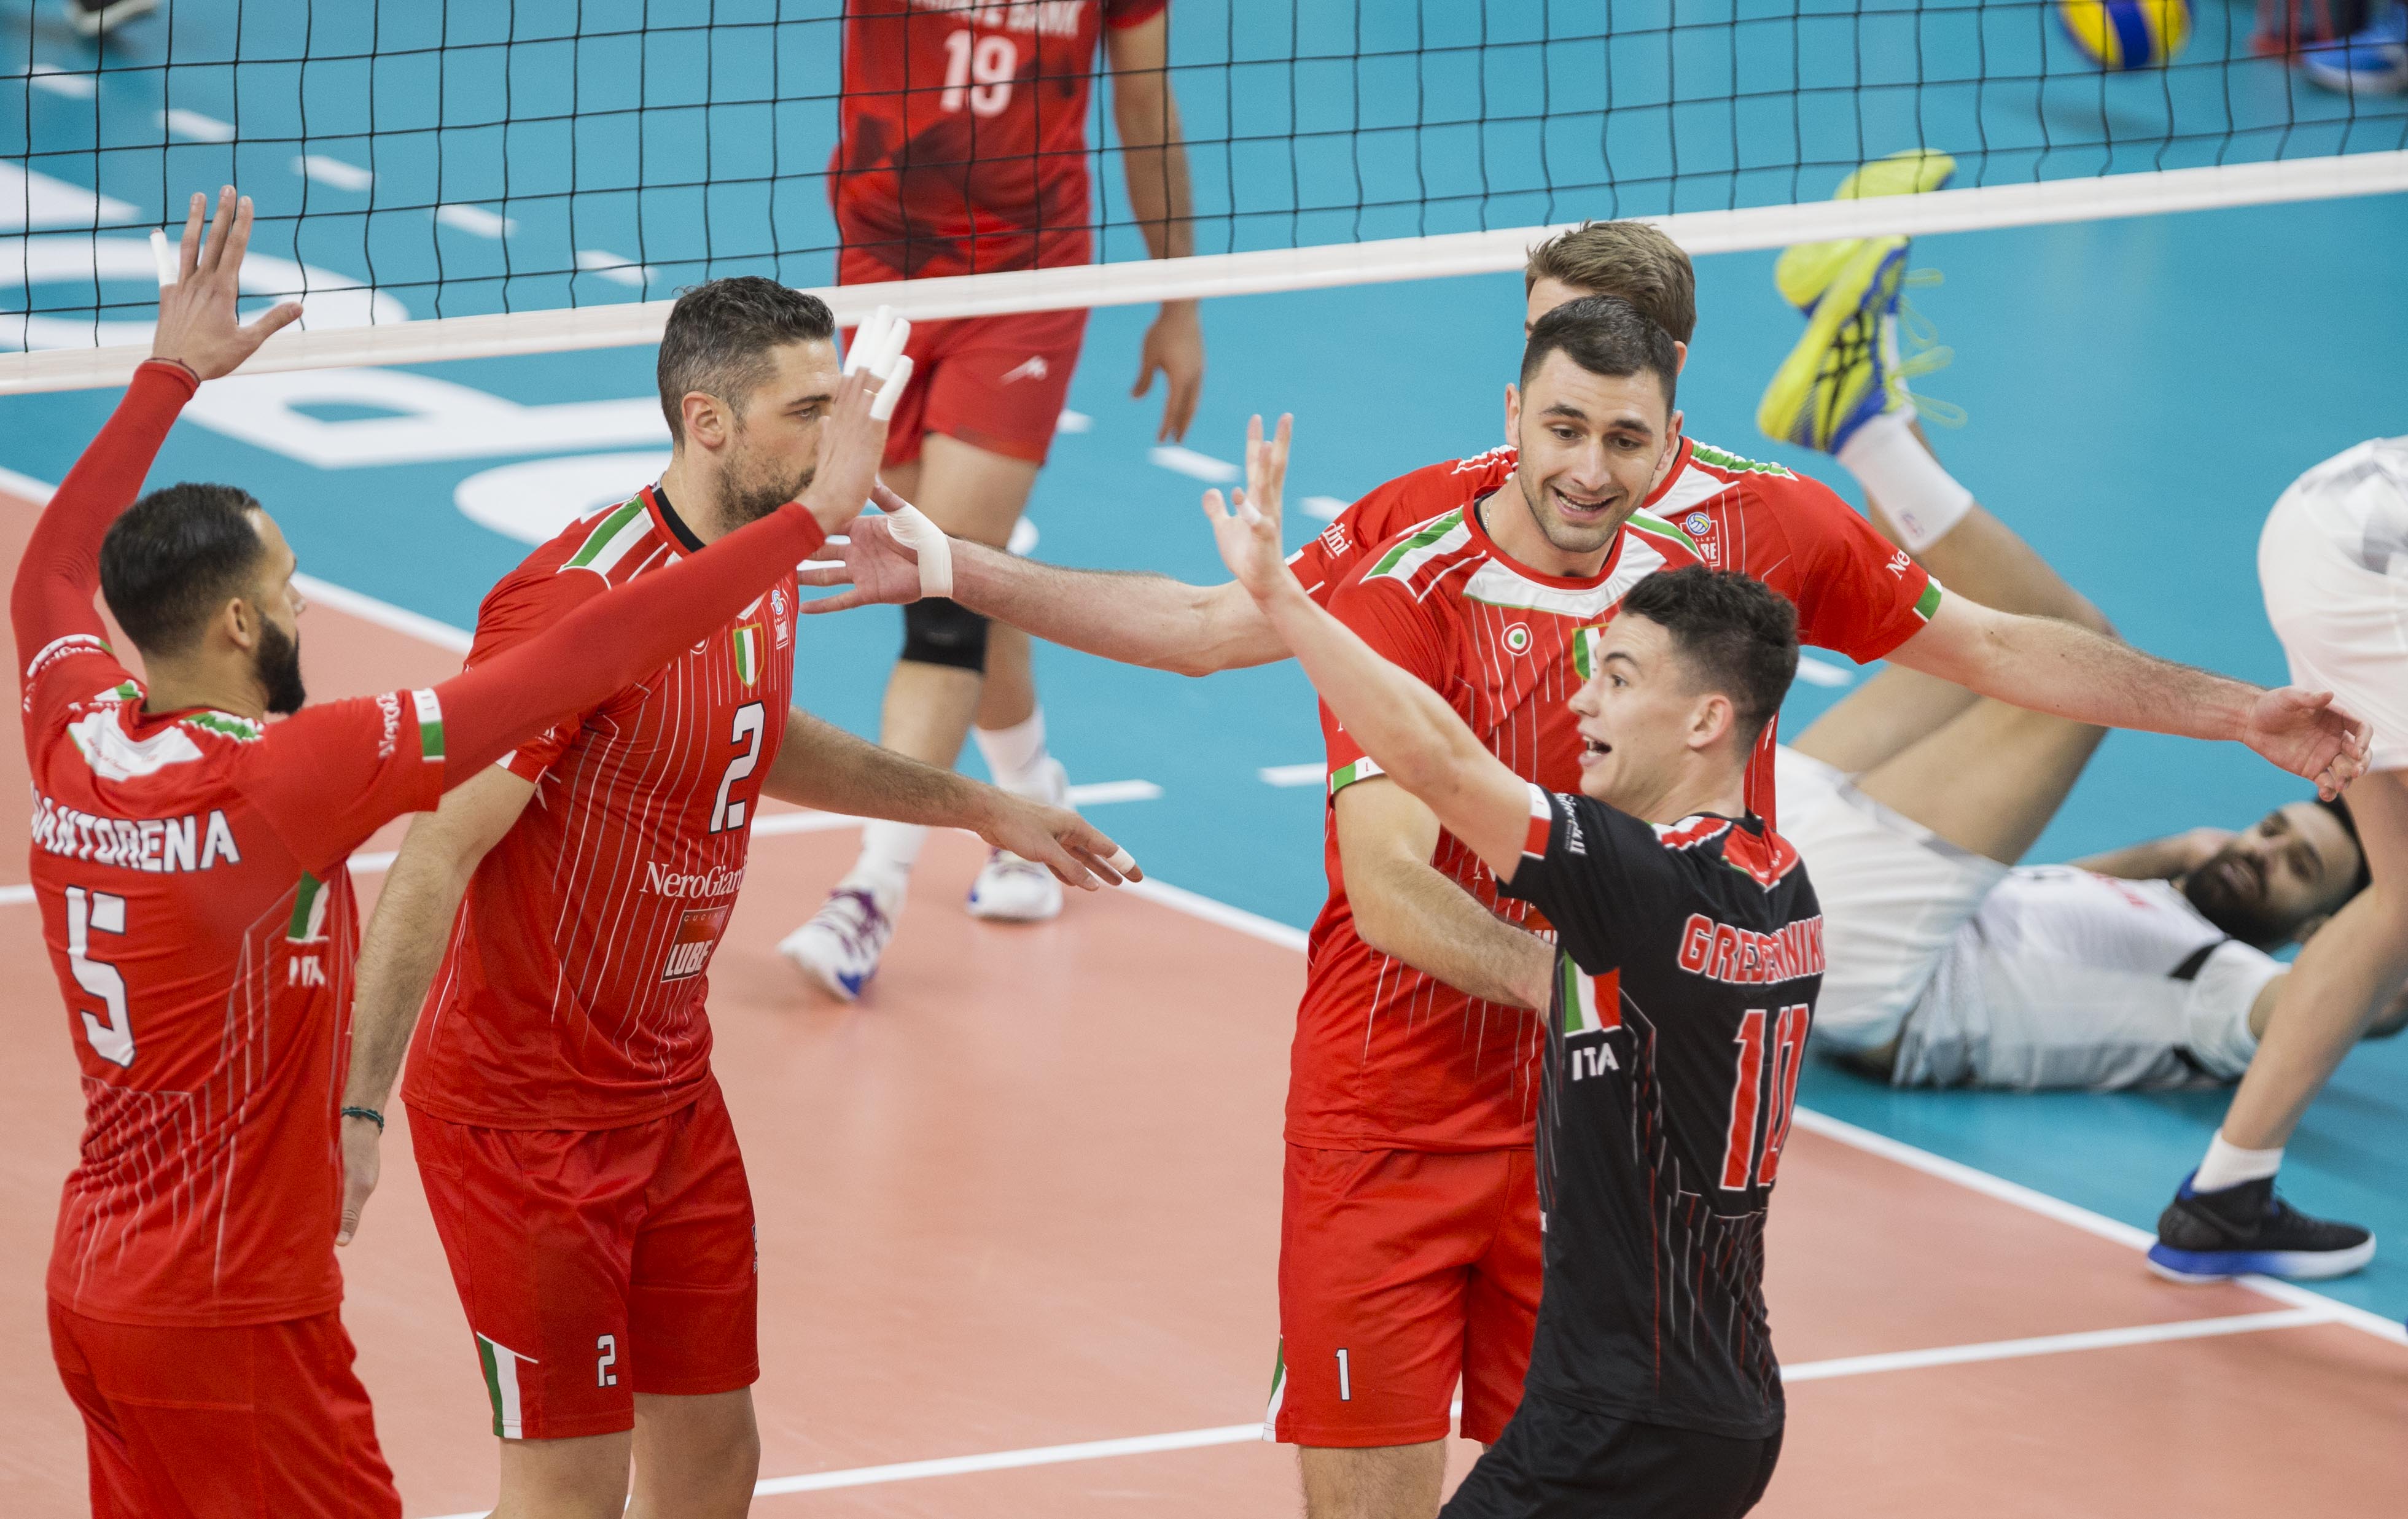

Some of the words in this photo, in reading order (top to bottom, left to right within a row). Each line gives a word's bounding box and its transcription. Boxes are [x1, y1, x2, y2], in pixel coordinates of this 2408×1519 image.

[939, 29, 1018, 118] 19
[709, 700, 766, 835] 2
[64, 884, 136, 1069] 5
[287, 955, 325, 987] ITA
[665, 939, 714, 976] LUBE
[1572, 1042, 1620, 1081] ITA
[1719, 1003, 1810, 1191] 10
[596, 1333, 617, 1388] 2
[1335, 1346, 1352, 1402] 1
